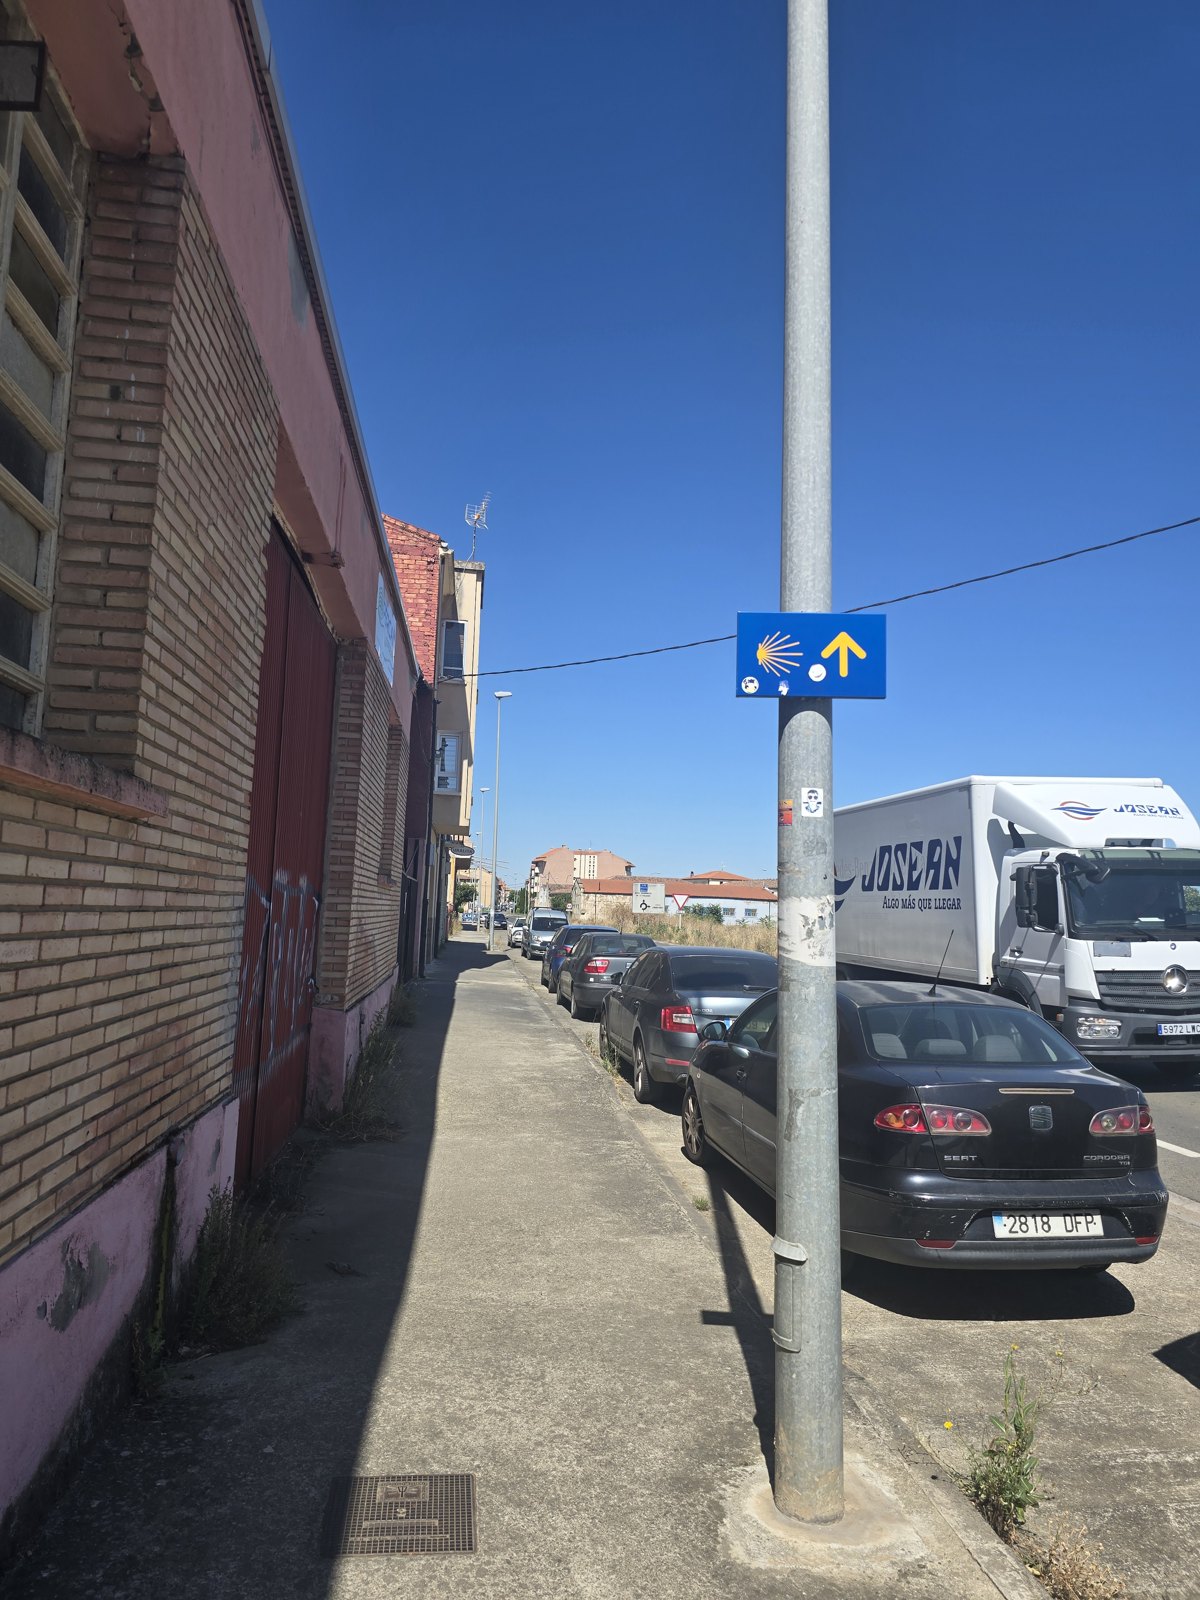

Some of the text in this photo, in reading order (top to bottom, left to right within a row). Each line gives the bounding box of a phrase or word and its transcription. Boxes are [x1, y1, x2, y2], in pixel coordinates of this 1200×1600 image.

[1113, 804, 1181, 816] JOSEAN
[861, 835, 962, 892] JOSEAN
[882, 894, 962, 912] ALGO MÁS QUE LLEGAR
[1163, 1025, 1184, 1034] 5972
[1006, 1213, 1094, 1234] 2818 DFP
